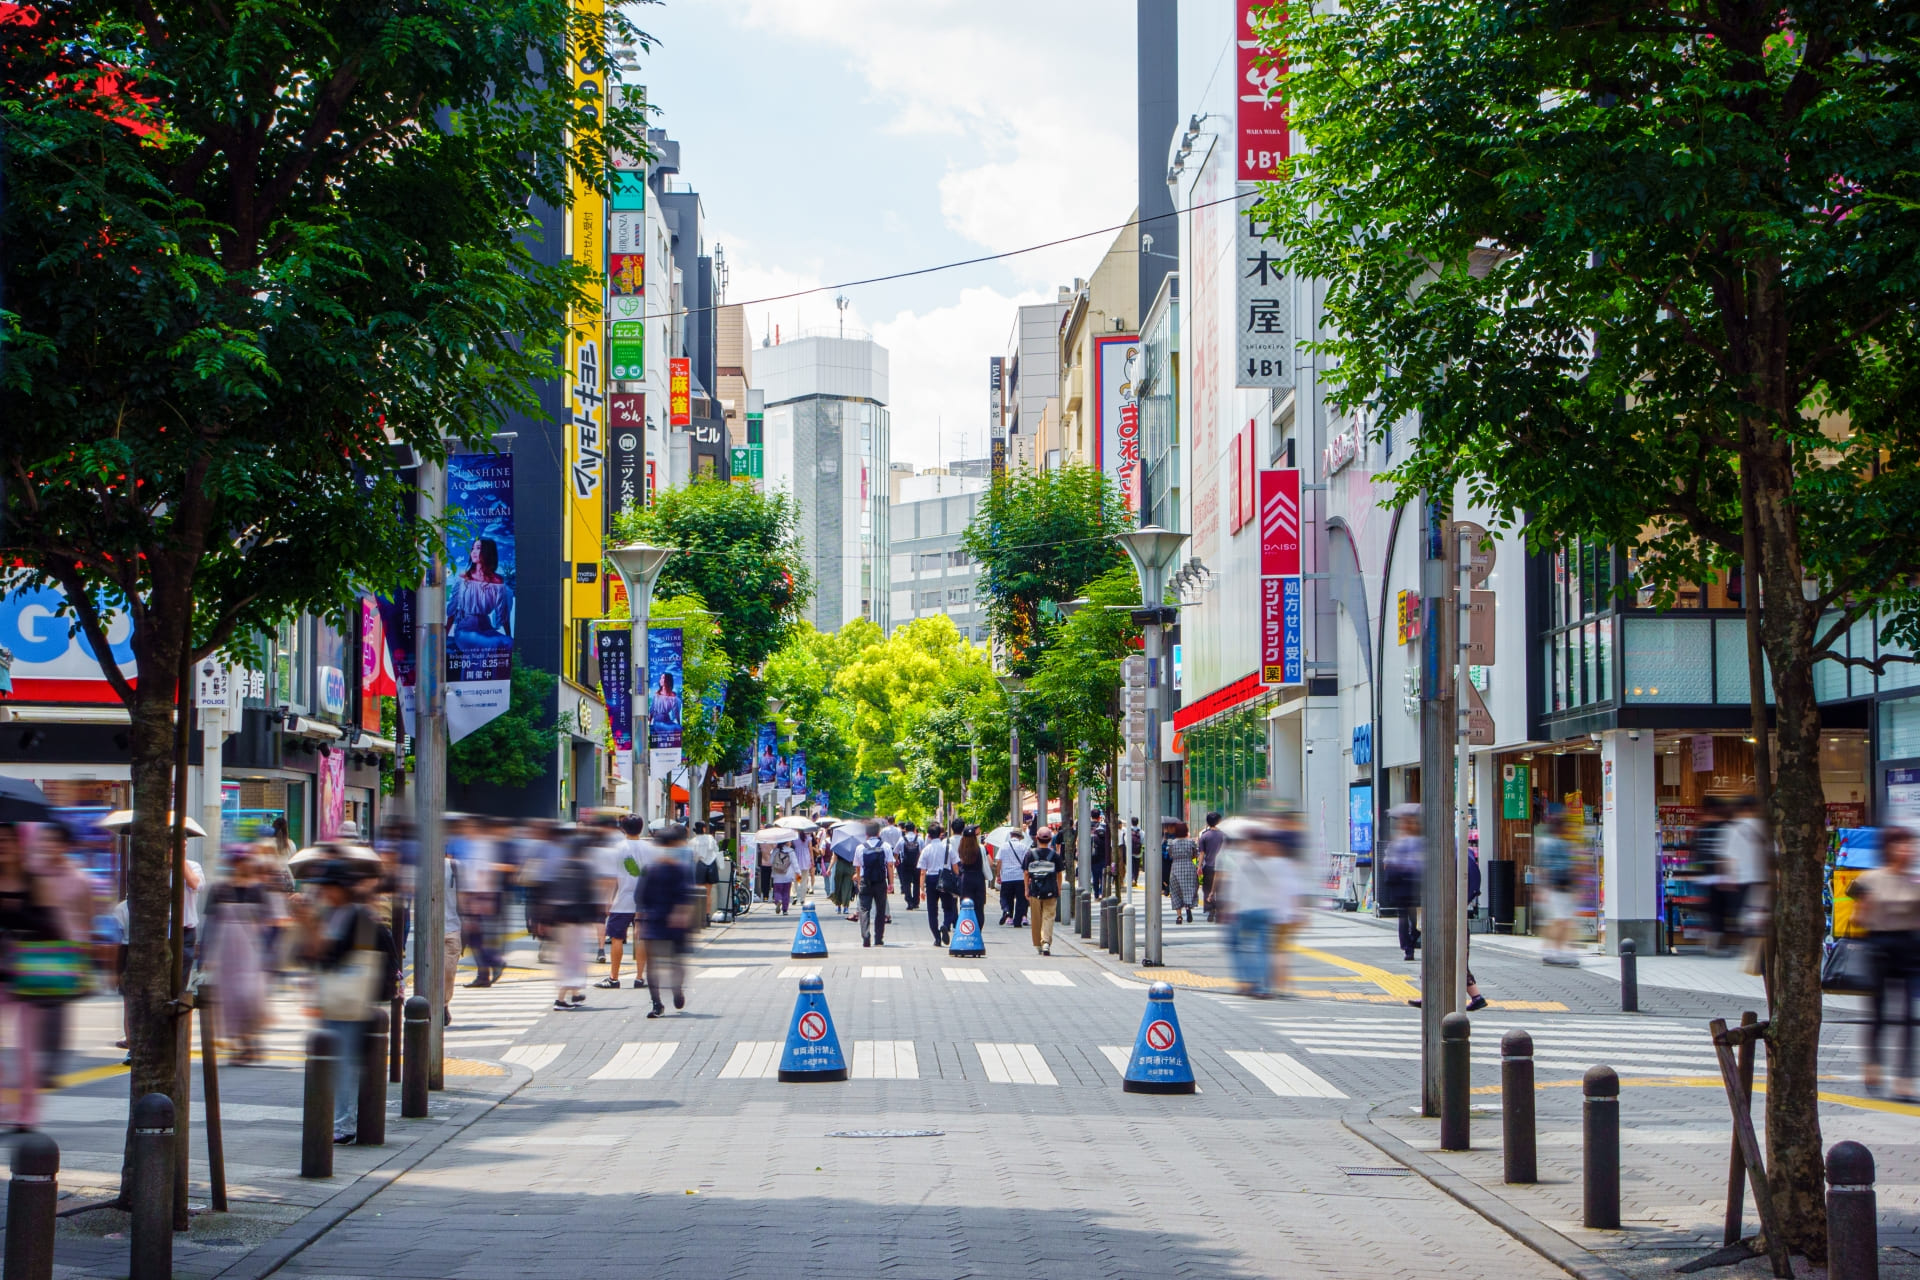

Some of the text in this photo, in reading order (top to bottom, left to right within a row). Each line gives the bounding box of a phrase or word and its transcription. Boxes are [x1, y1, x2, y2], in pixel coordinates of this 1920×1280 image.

[1259, 151, 1281, 169] B1
[1260, 360, 1282, 377] B1
[672, 376, 688, 414] 麻雀
[613, 399, 634, 409] つけ
[574, 343, 602, 496] マツモトキヨシ
[621, 410, 641, 422] めん
[452, 480, 510, 490] AQUARIUM
[474, 507, 511, 516] KURAKI
[1264, 543, 1297, 551] DAISO
[1265, 580, 1279, 662] サンドラッグ
[1285, 581, 1299, 677] 処方せん受付
[466, 670, 492, 680] 開催中
[1266, 667, 1280, 680] 薬
[1713, 776, 1729, 788] 2F
